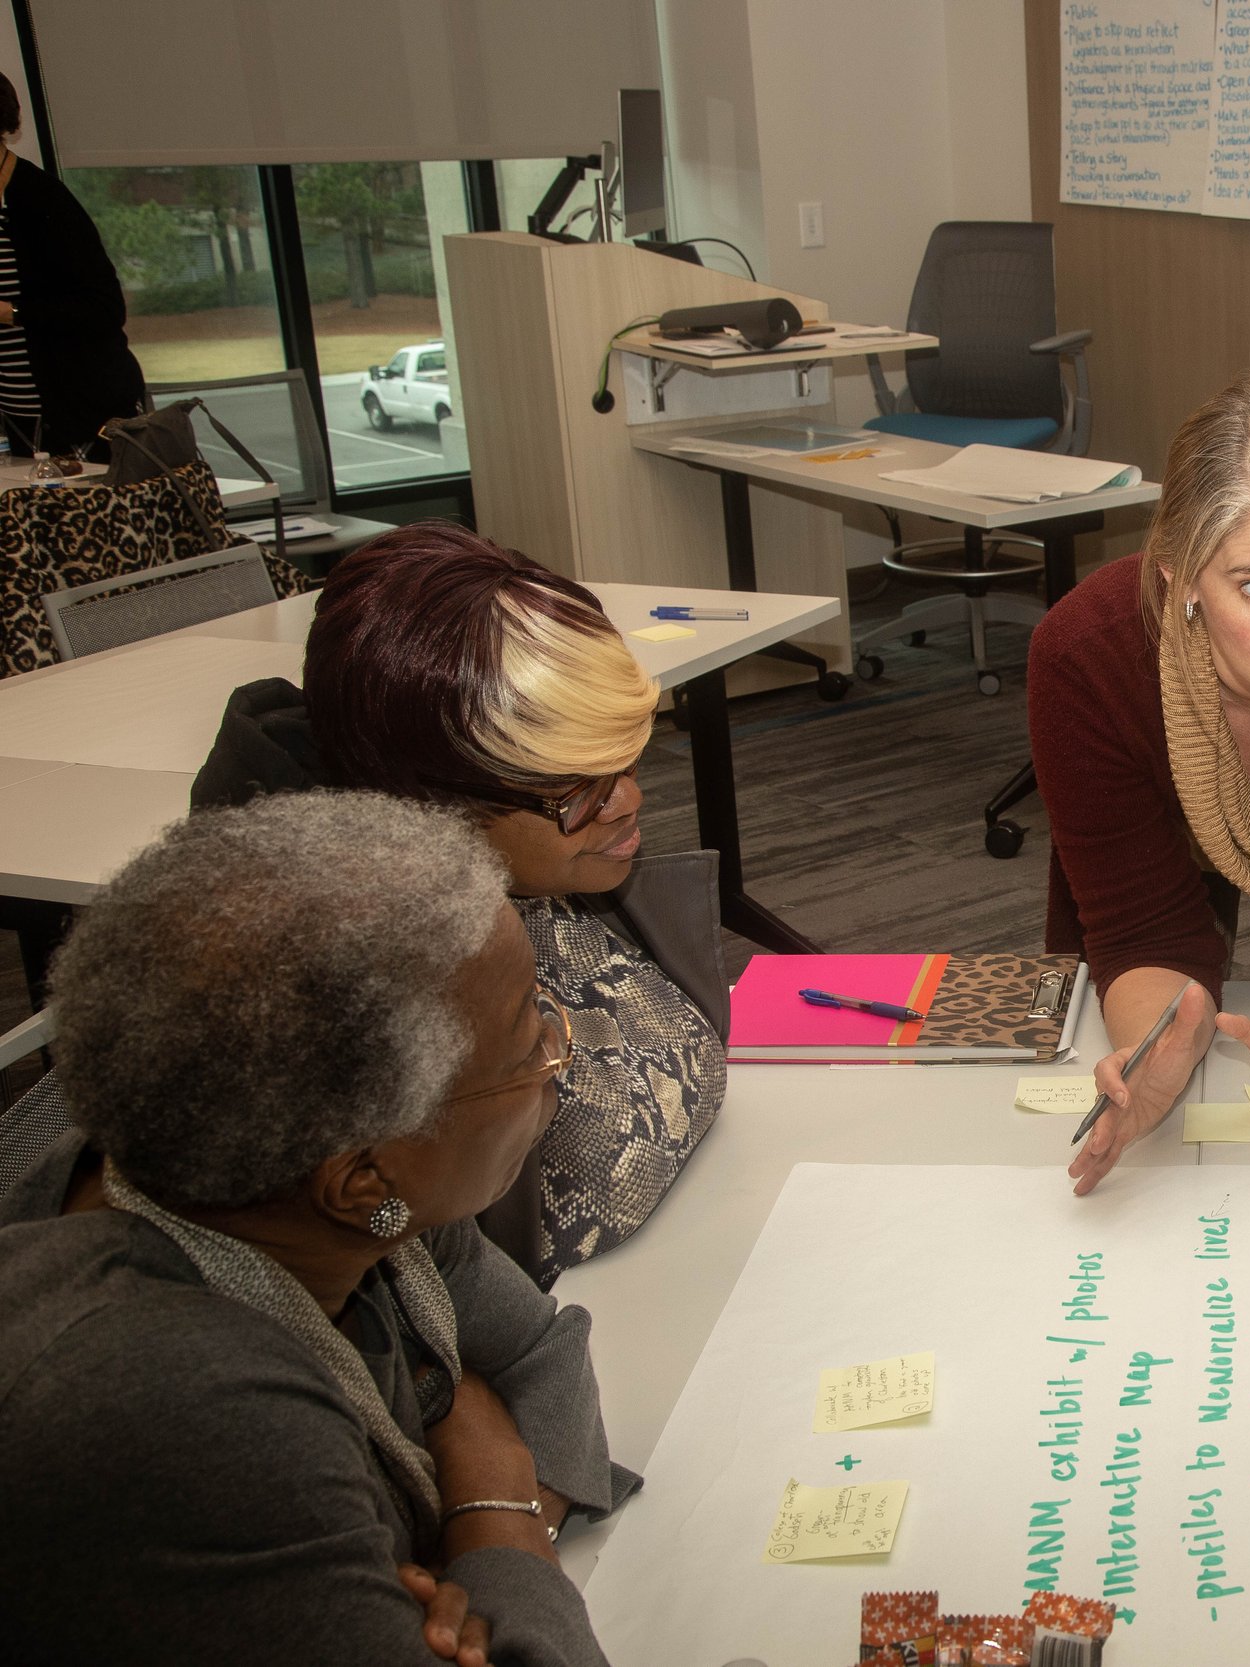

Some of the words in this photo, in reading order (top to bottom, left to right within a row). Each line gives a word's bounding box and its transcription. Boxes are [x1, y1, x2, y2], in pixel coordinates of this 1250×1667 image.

[1194, 1215, 1231, 1260] lives
[1061, 1252, 1109, 1321] photos
[1046, 1335, 1106, 1363] w/
[1119, 1351, 1174, 1407] Map
[1038, 1375, 1083, 1482] exhibit
[1186, 1443, 1226, 1471] to
[901, 1639, 920, 1667] KI
